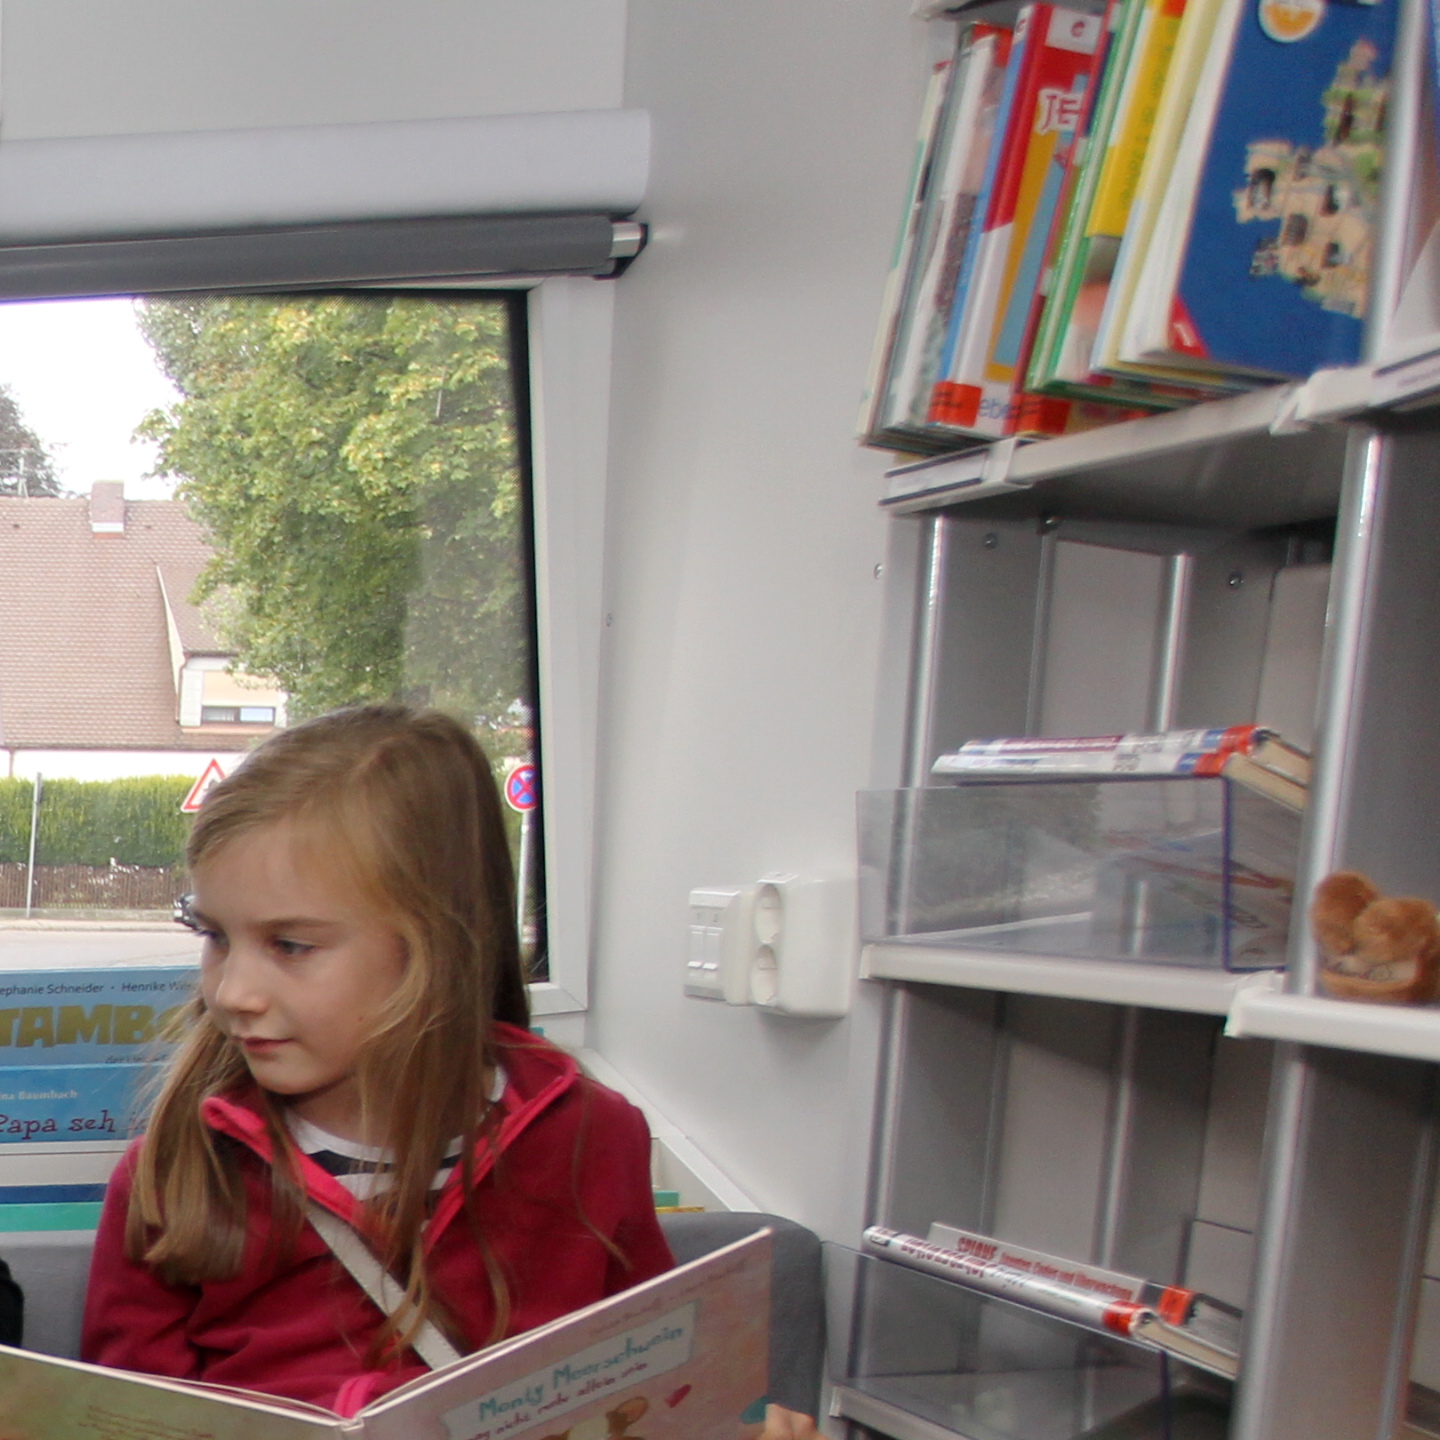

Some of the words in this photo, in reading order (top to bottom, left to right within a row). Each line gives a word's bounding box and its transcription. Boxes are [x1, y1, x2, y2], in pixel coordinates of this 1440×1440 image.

[47, 982, 104, 996] Schneider
[121, 981, 166, 993] Henrike
[17, 1088, 78, 1101] Baumbach
[67, 1109, 117, 1133] seh
[551, 1324, 686, 1392] Meerschwein
